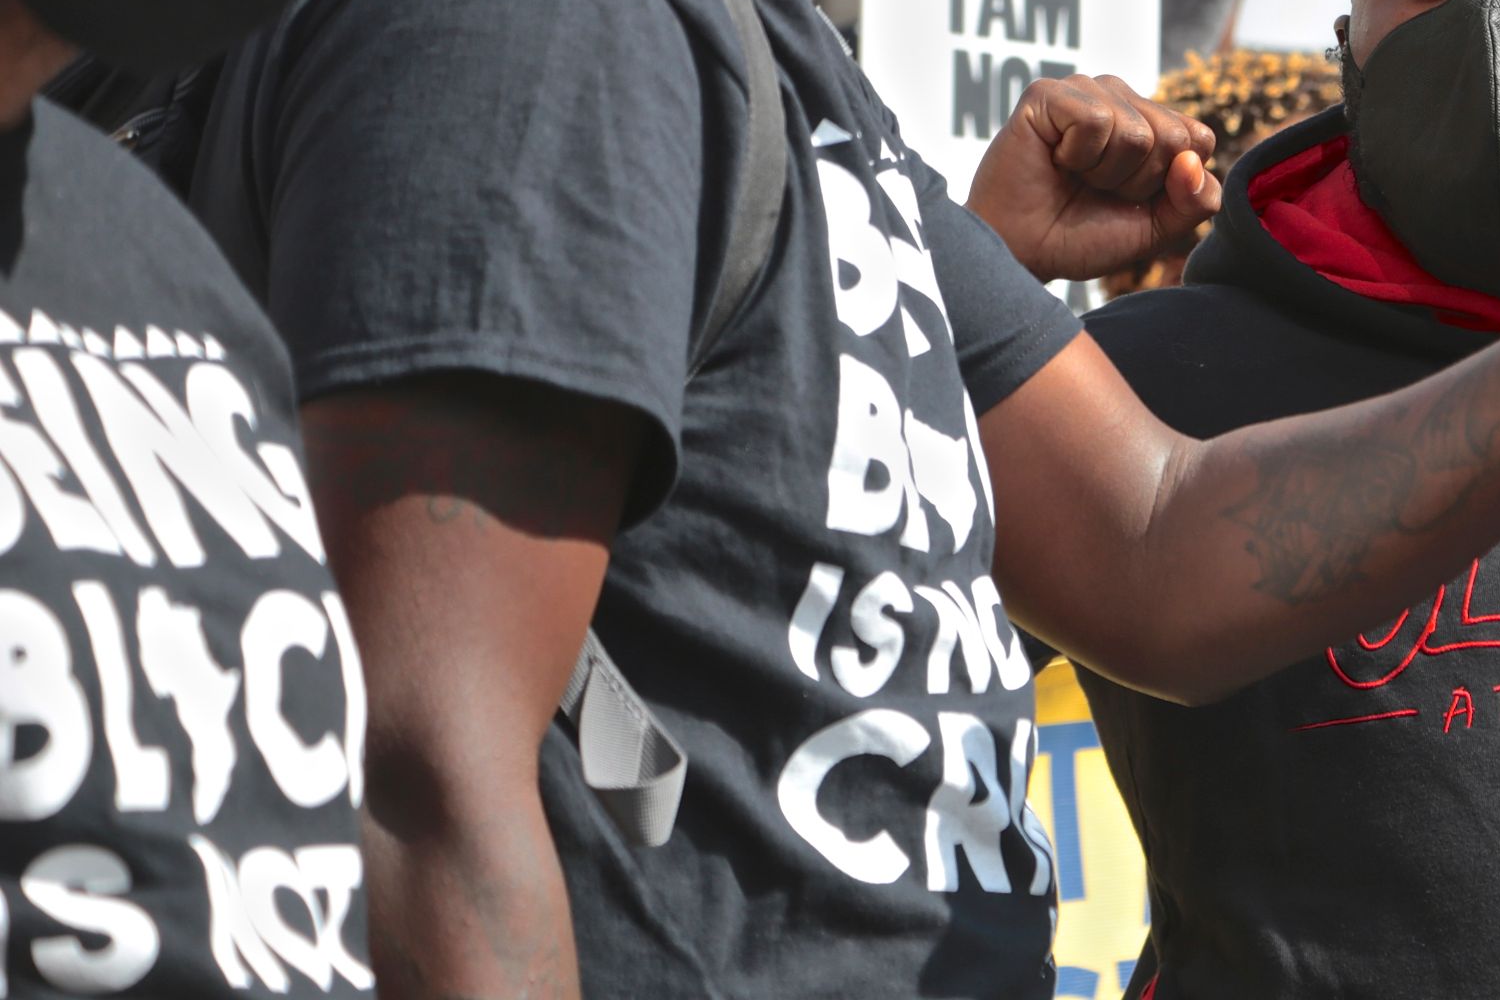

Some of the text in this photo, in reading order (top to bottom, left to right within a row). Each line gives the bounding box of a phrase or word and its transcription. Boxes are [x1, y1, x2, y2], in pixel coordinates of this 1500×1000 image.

[0, 346, 327, 568] EING
[788, 561, 1030, 698] IS NO
[777, 708, 1058, 897] CRI
